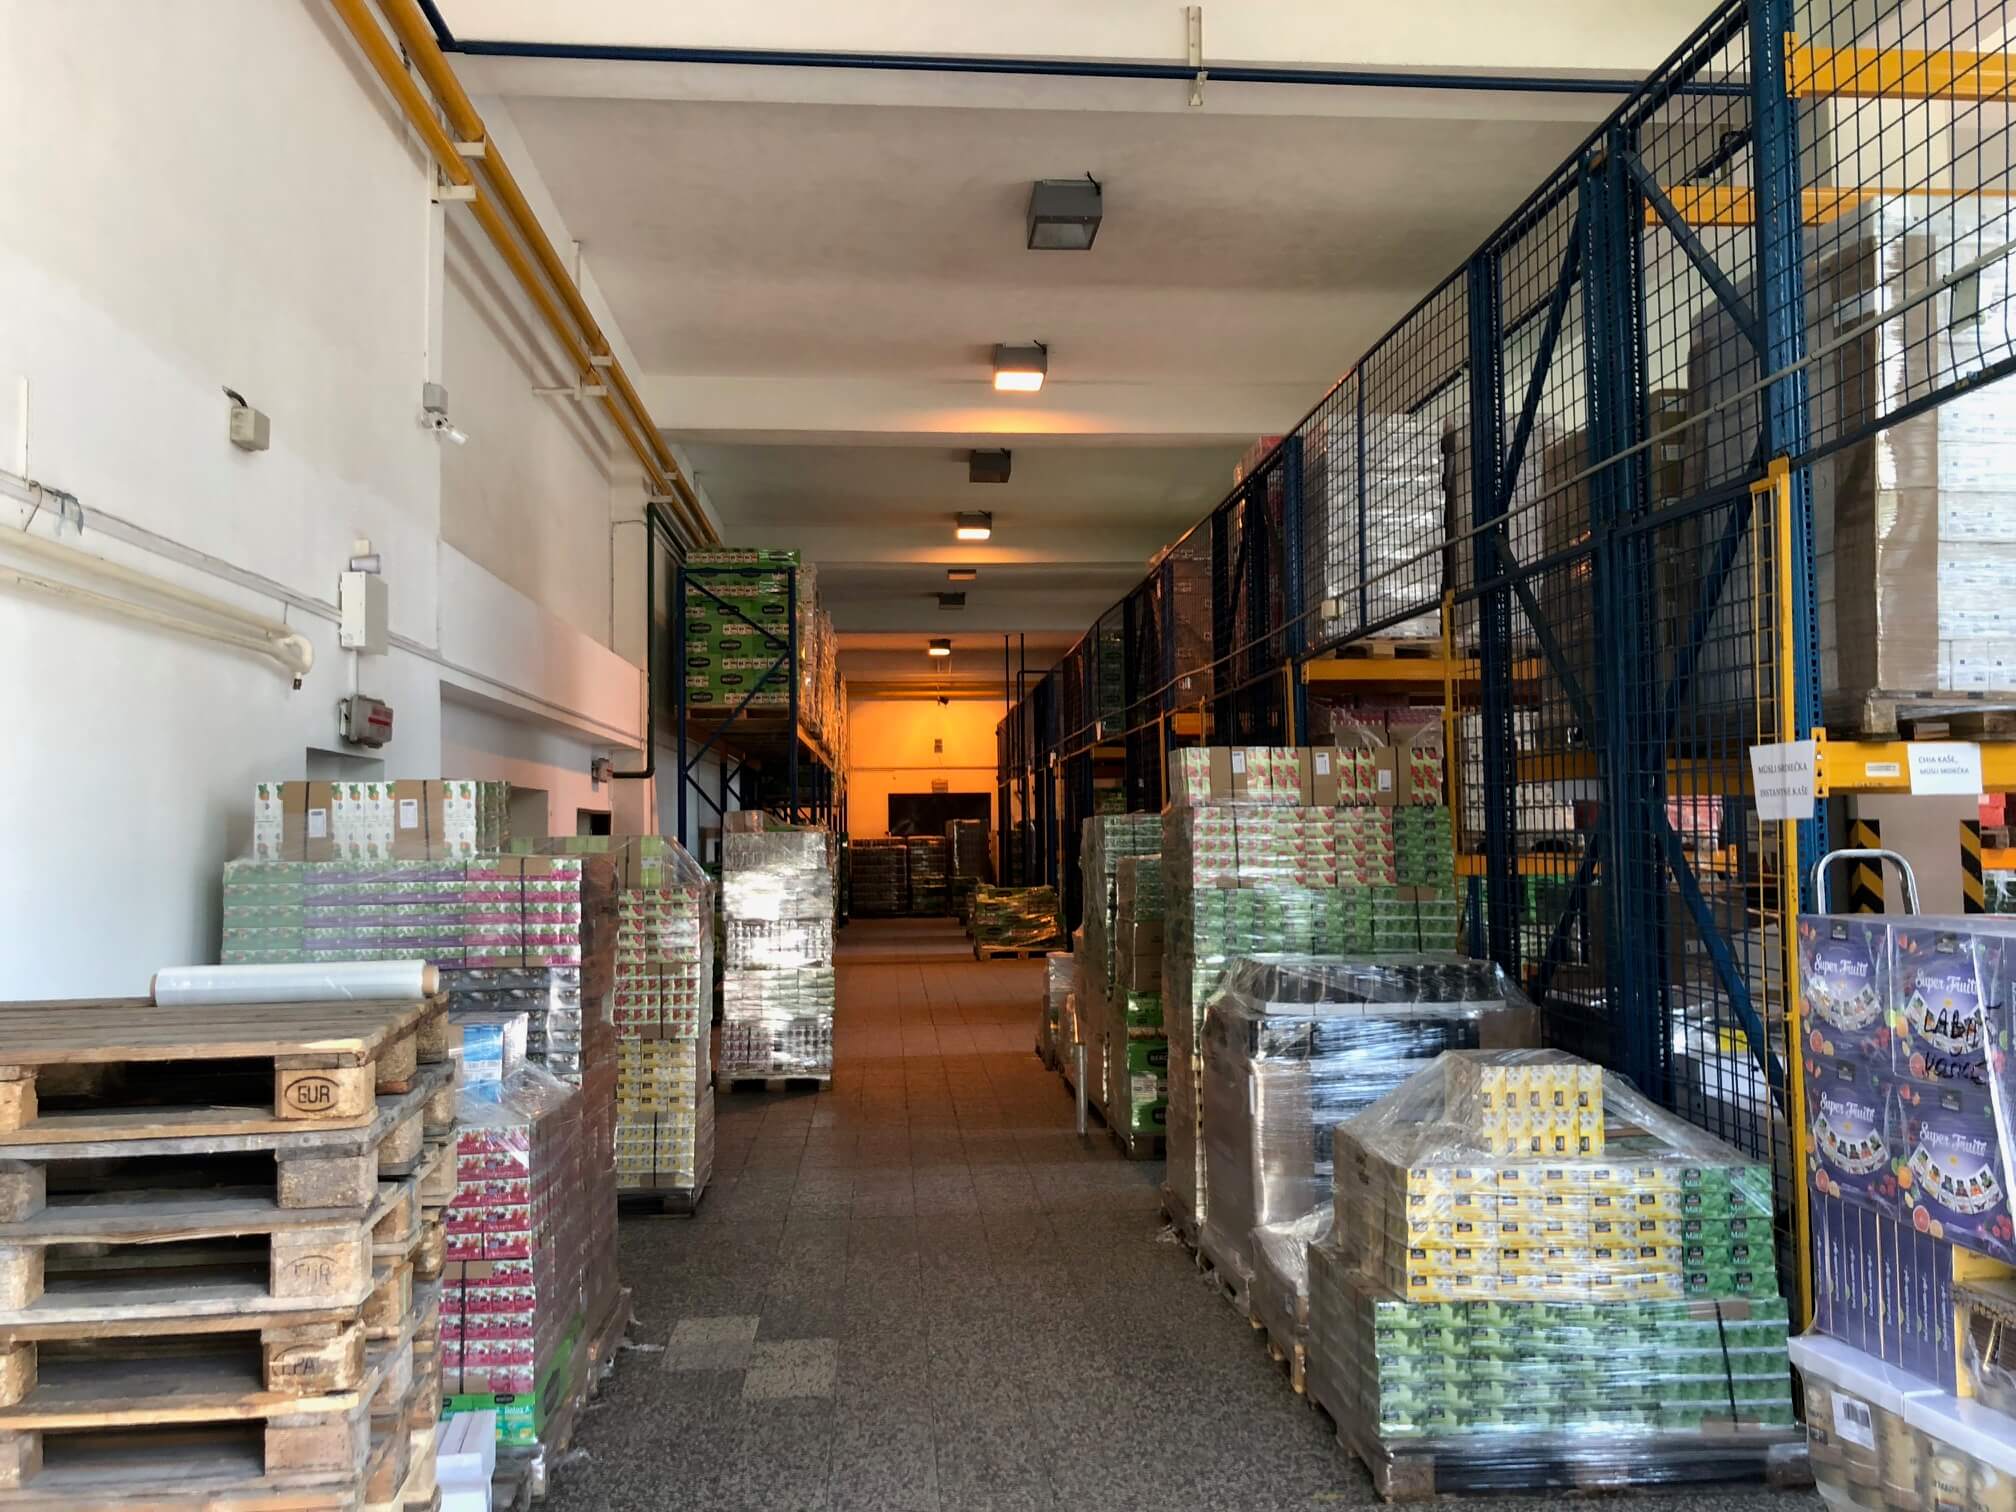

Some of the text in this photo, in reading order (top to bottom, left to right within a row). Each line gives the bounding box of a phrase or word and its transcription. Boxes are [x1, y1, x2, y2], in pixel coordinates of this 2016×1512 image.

[1815, 953, 1869, 977] Super Fruits
[1915, 968, 1944, 994] Super
[297, 1085, 331, 1104] EUR
[1820, 1091, 1876, 1123] Super Fruits
[1919, 1120, 1987, 1157] Super Fruits
